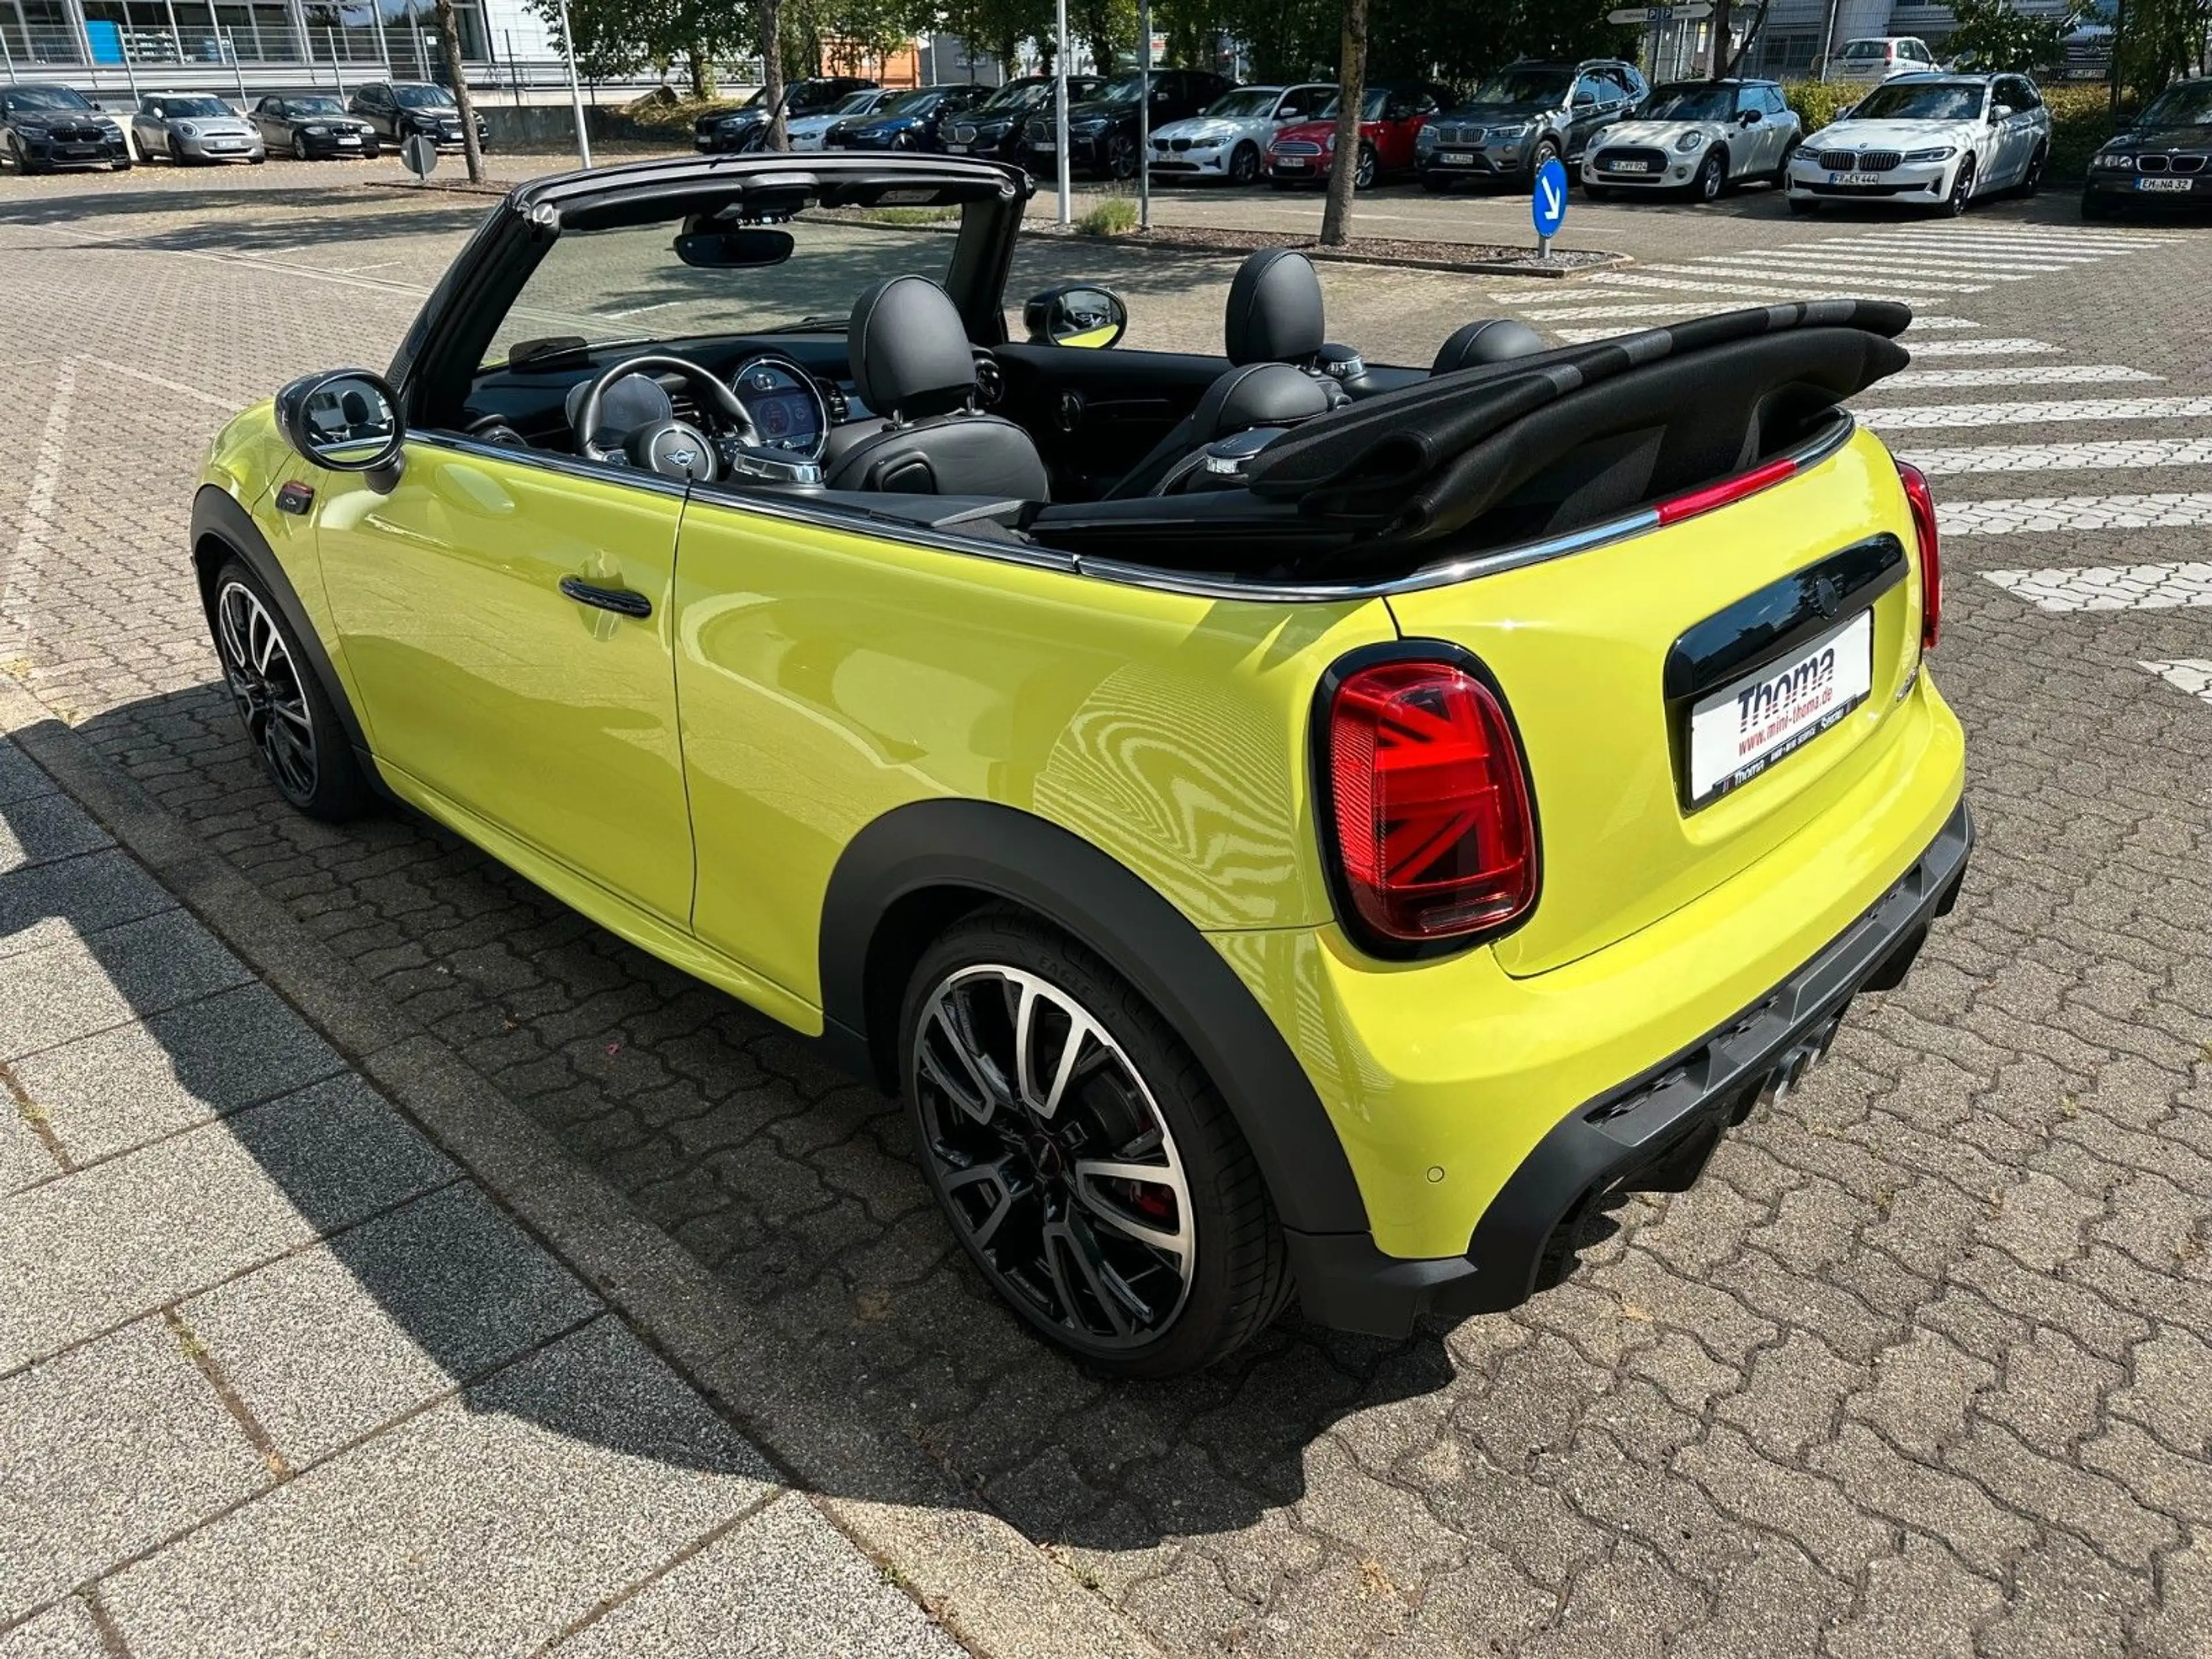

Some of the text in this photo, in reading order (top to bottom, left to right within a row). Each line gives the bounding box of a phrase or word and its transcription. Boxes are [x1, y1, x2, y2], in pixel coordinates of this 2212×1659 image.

[2175, 180, 2188, 189] 32
[1738, 647, 1835, 733] Thoma
[1738, 685, 1833, 756] www.mini-thoma.de
